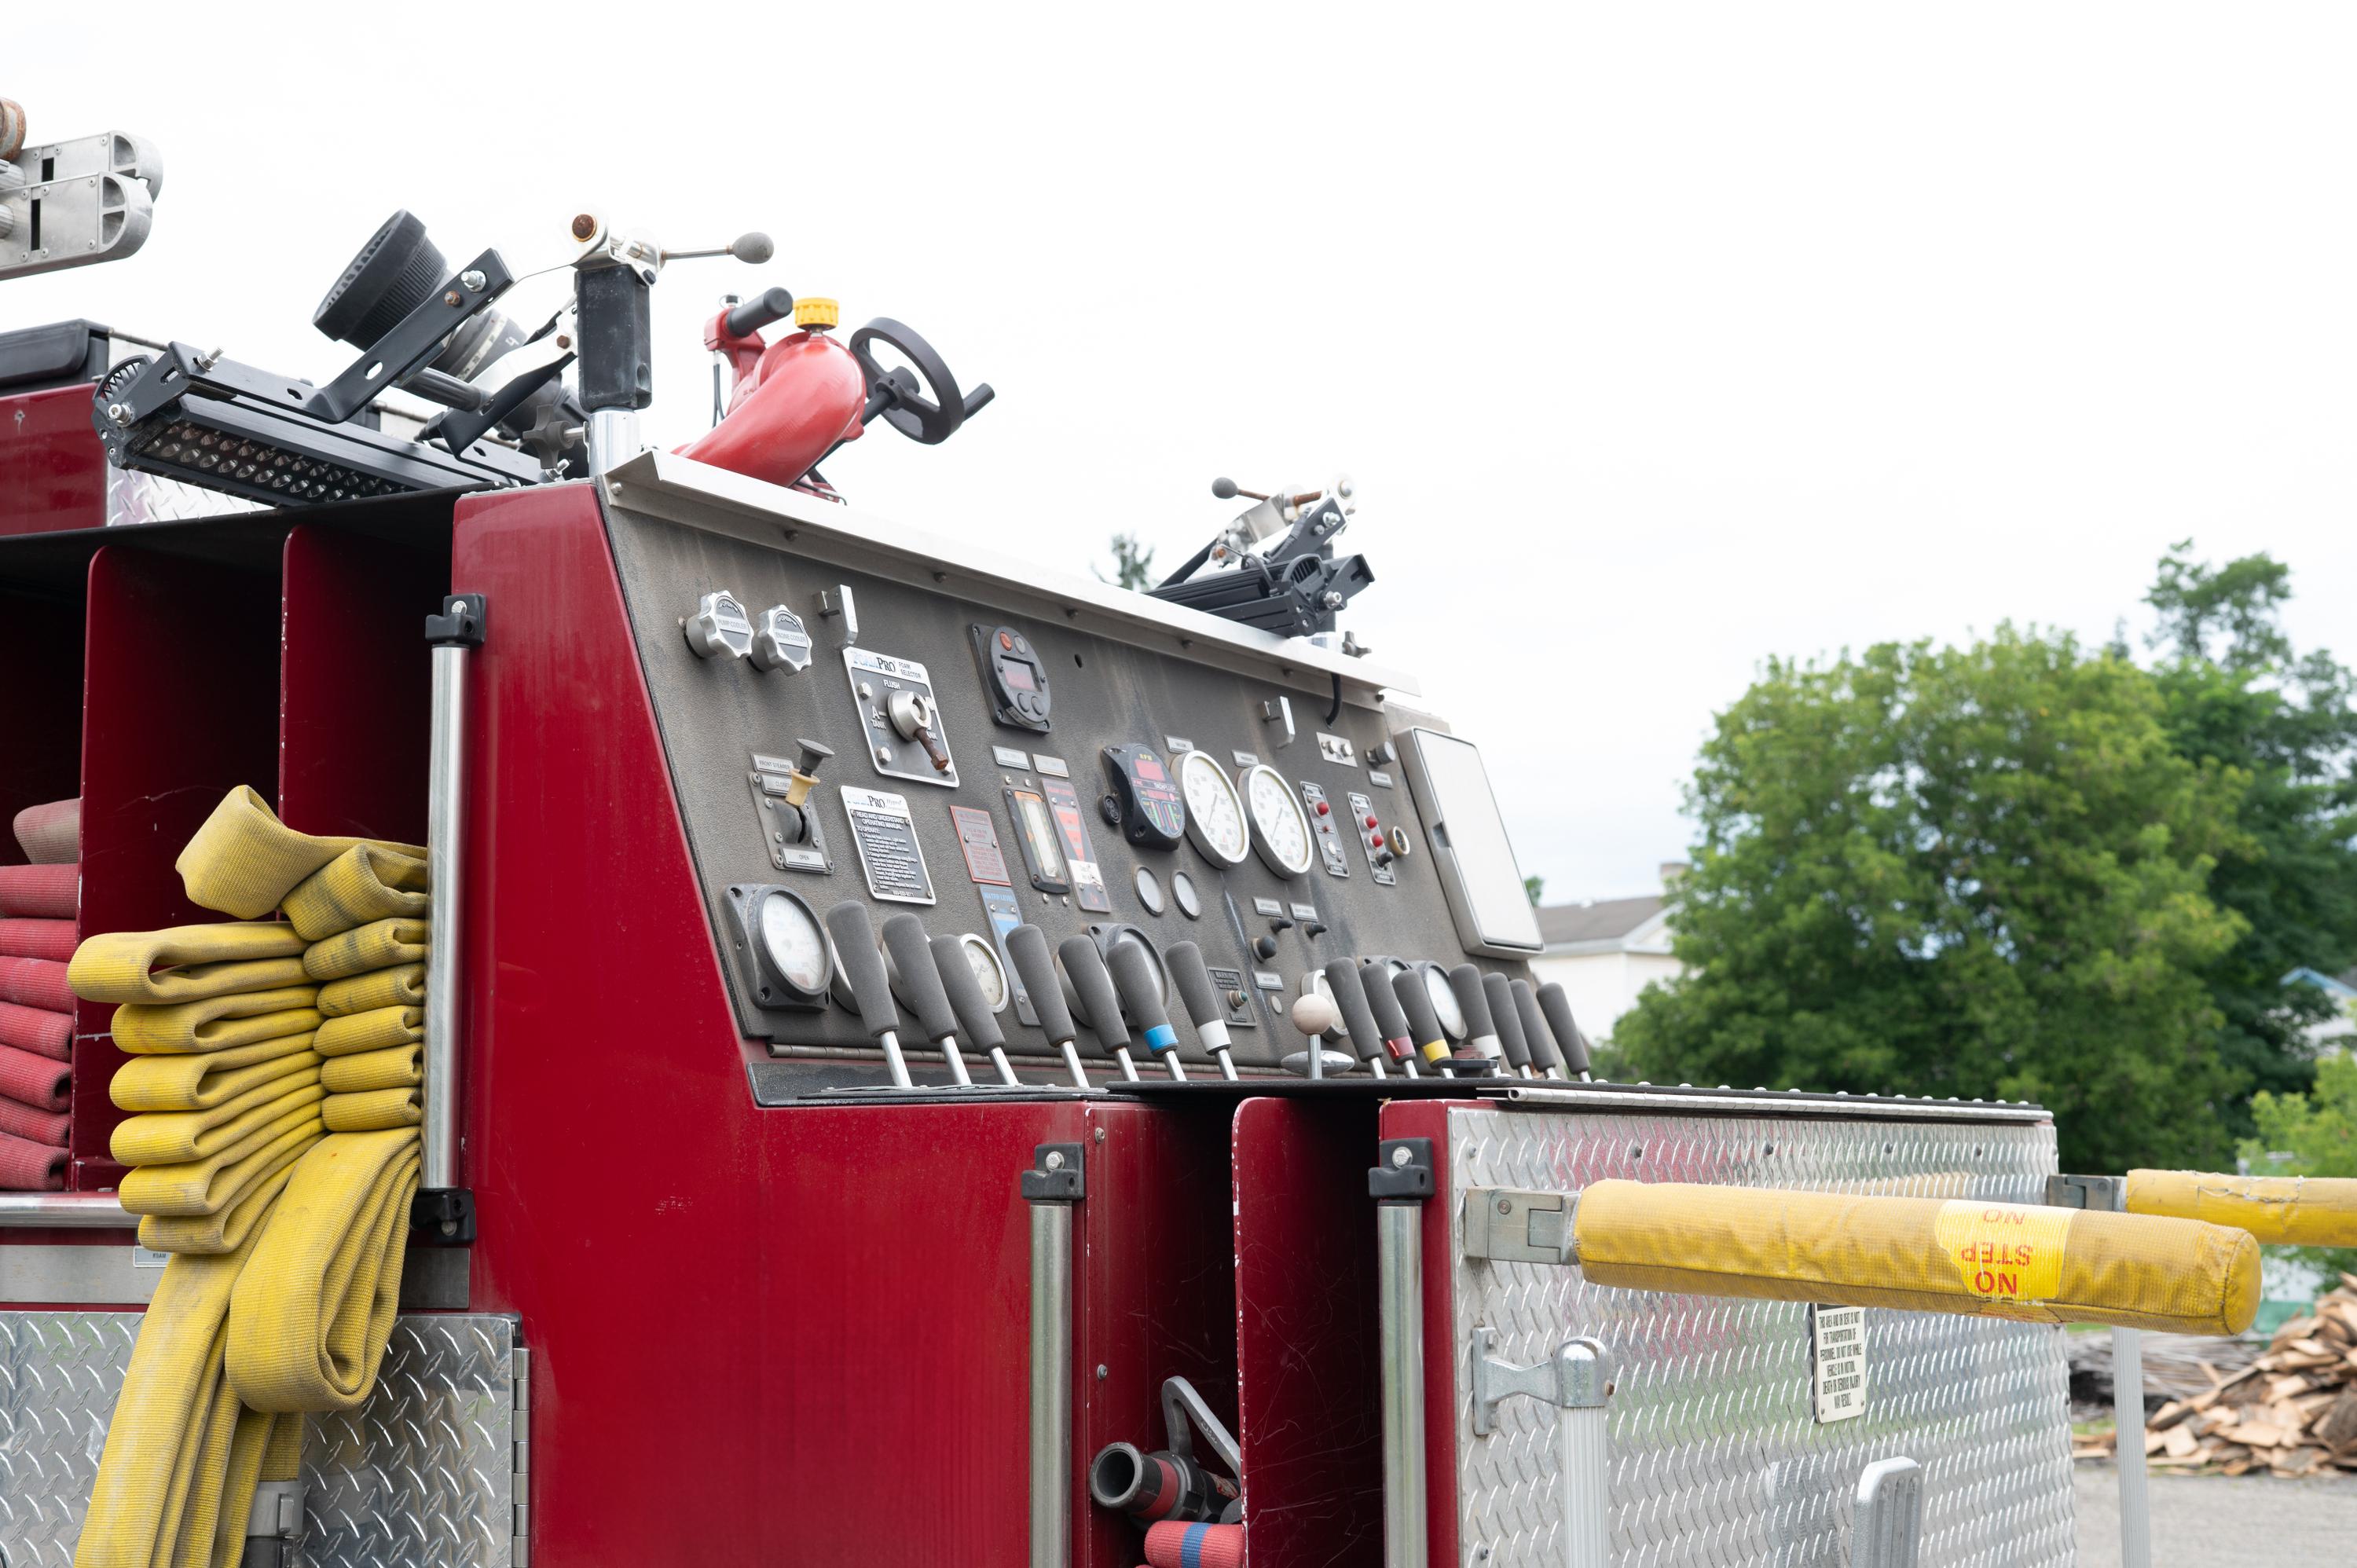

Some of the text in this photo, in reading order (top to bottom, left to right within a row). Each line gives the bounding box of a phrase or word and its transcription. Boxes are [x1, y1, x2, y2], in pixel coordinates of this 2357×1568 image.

[775, 632, 806, 643] ENGINE COOLER
[883, 679, 900, 690] FLUSH
[871, 705, 880, 720] A
[871, 719, 887, 731] TANK
[1961, 1240, 2033, 1266] STEP
[1975, 1271, 2017, 1295] NO
[1823, 1375, 1860, 1394] DEATH OR SERIOUS INJURY
